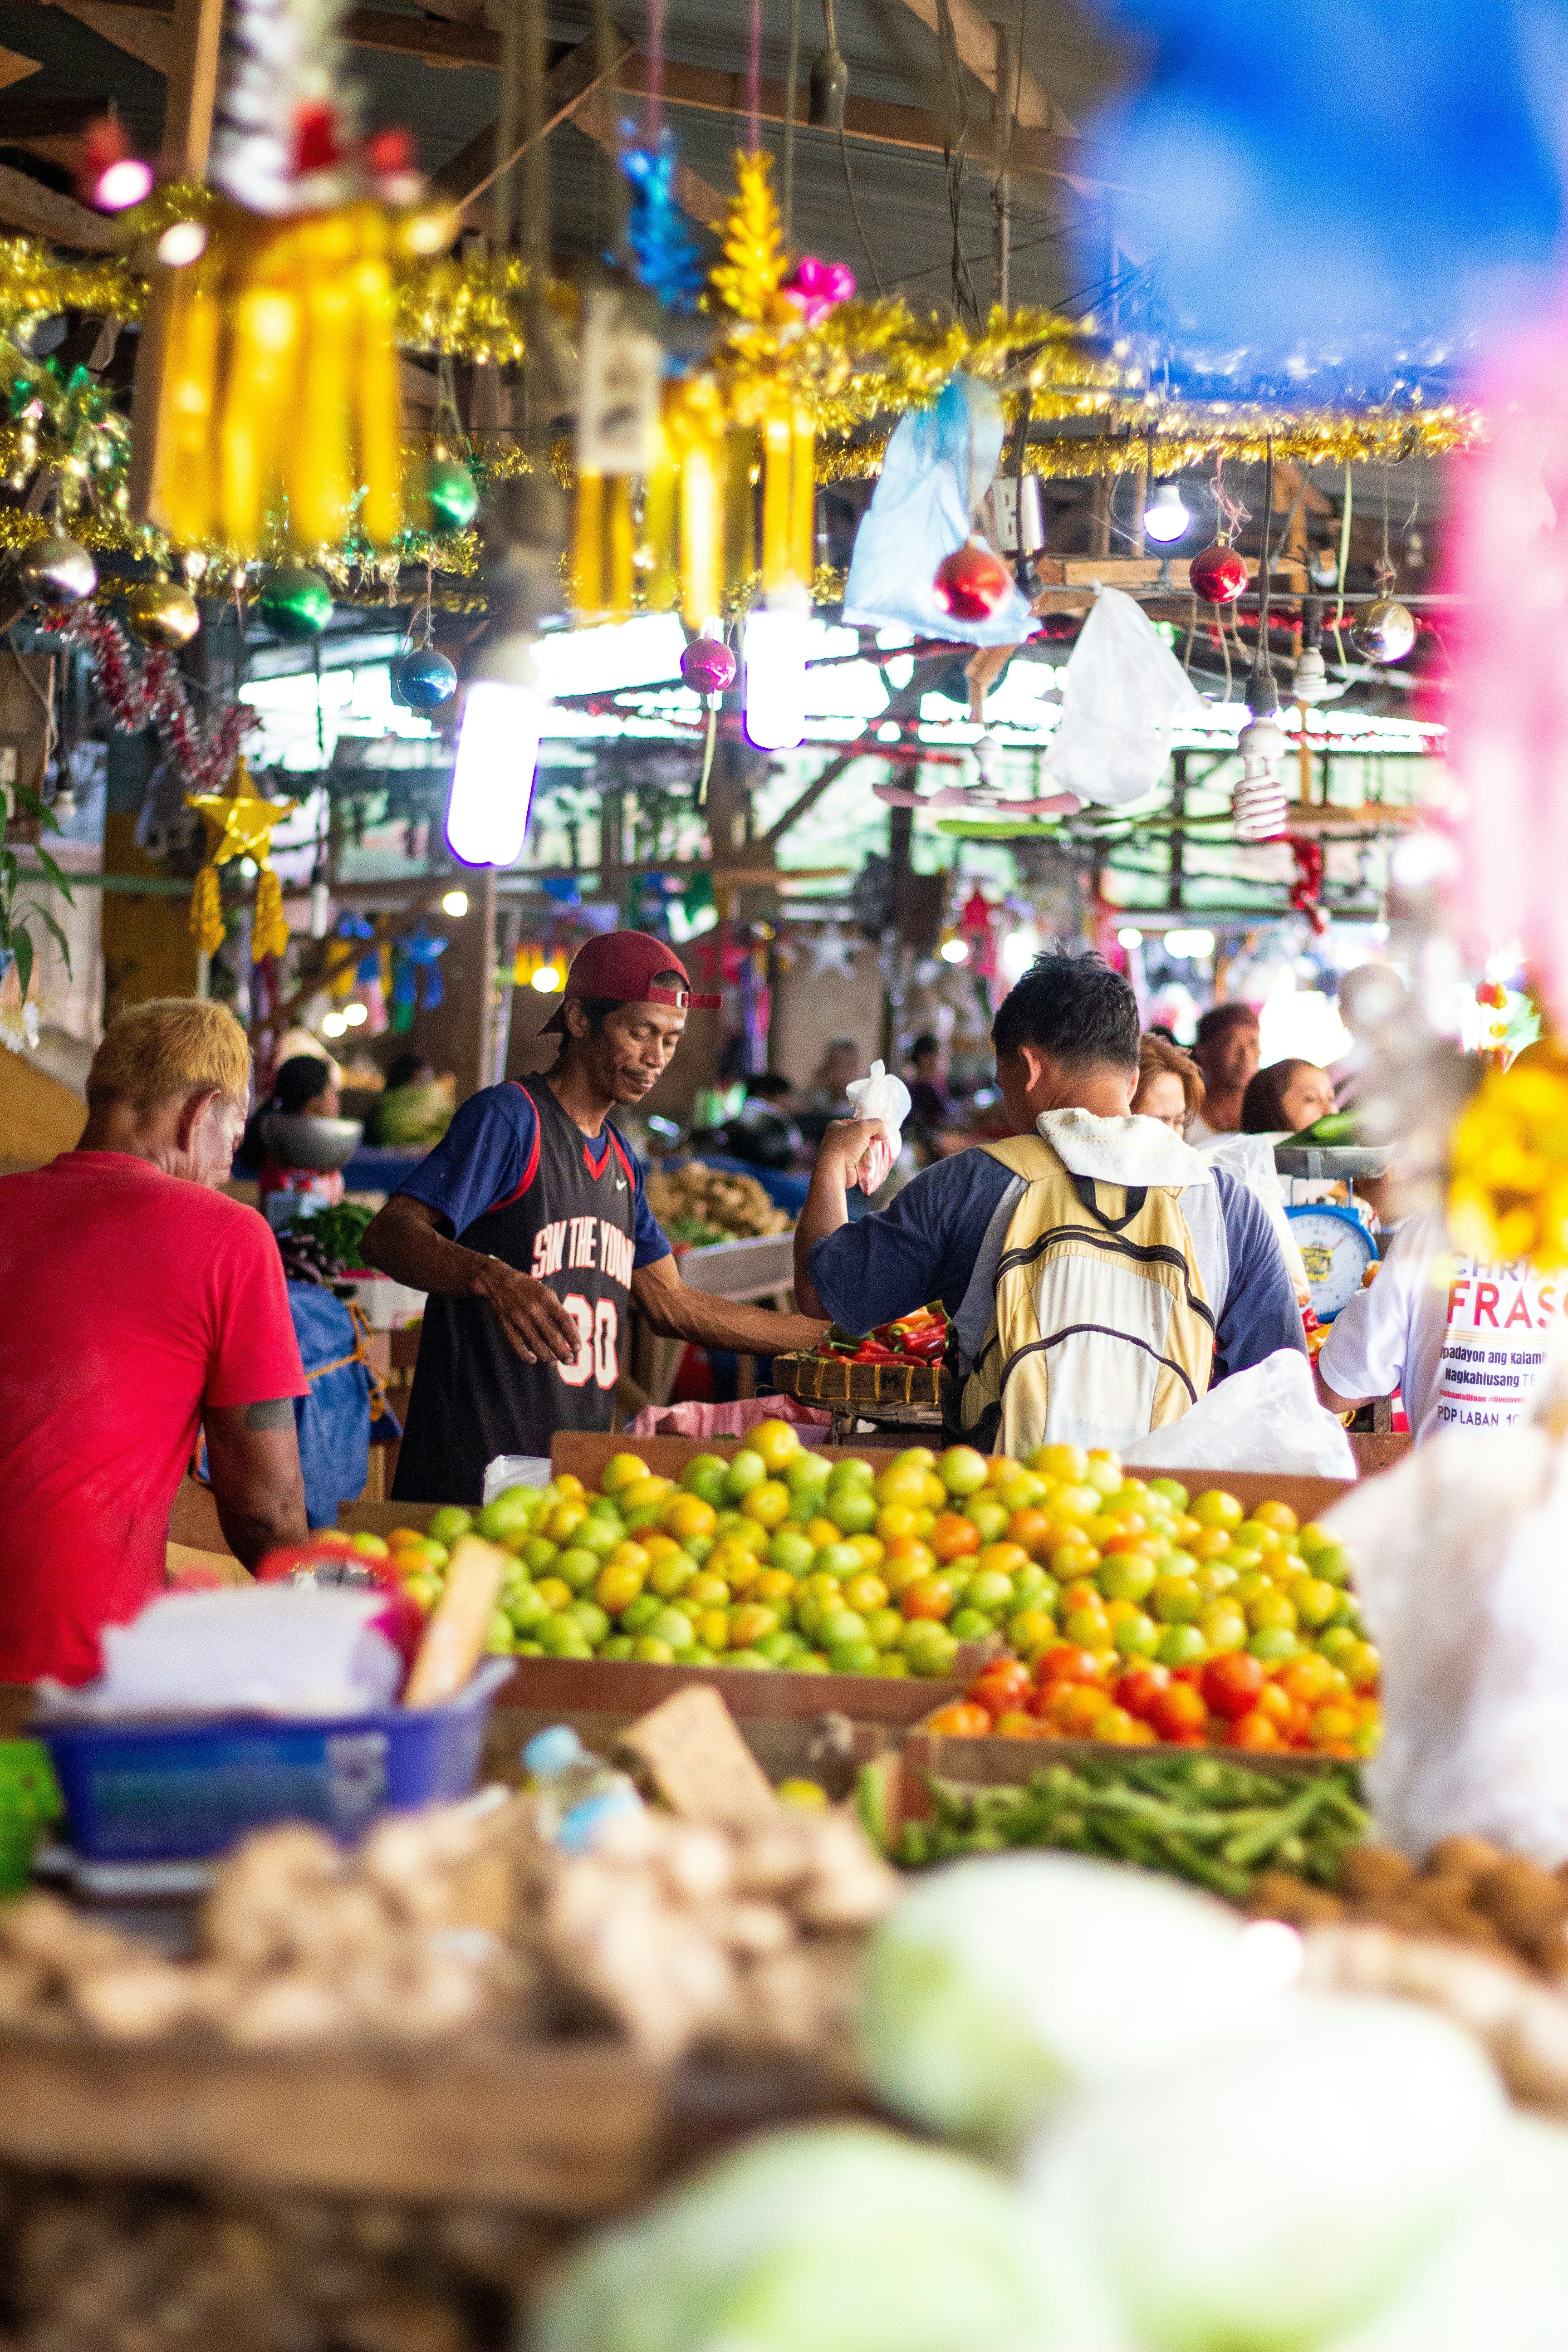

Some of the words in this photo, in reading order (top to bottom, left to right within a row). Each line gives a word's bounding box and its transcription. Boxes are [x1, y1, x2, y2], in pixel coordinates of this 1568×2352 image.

[568, 1216, 598, 1269] THE
[600, 1220, 636, 1291] YOUN
[1451, 1251, 1539, 1281] CHRI
[1447, 1279, 1568, 1329] FRAS
[1488, 1351, 1507, 1365] ang
[1445, 1367, 1519, 1387] Nagkahiusang
[1522, 1373, 1538, 1386] TE
[1438, 1406, 1457, 1422] PDP
[1460, 1410, 1499, 1426] LABAN
